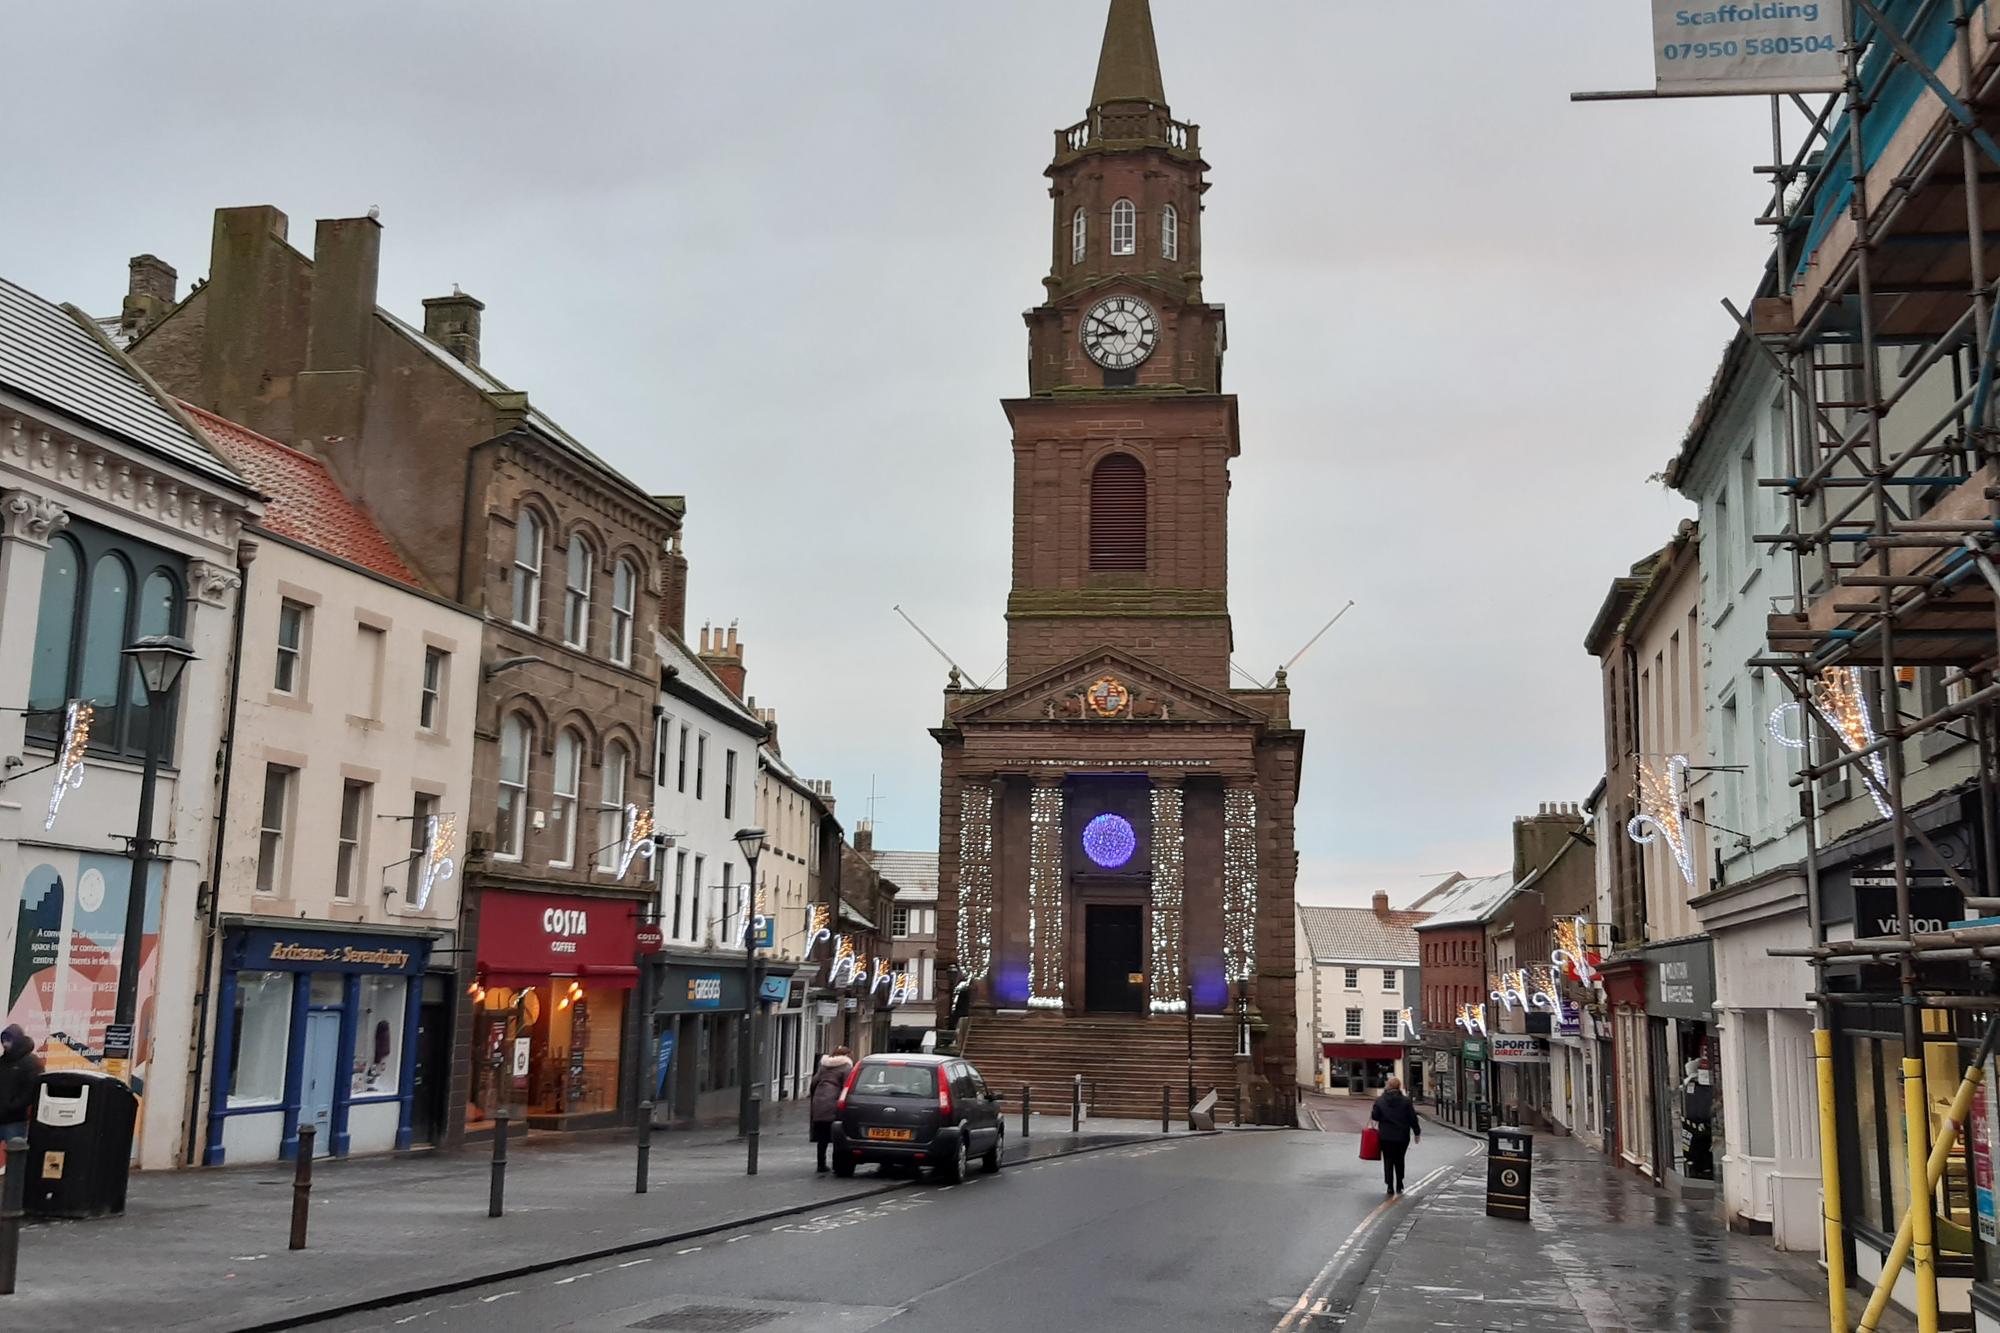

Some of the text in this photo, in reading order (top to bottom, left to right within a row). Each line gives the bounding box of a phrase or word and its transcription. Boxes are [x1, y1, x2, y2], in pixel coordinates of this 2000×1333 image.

[1676, 3, 1818, 26] Scaffolding
[1664, 35, 1835, 60] 07950 580504
[543, 907, 587, 937] COSTA
[342, 946, 410, 968] Serendipity
[551, 941, 577, 953] COFFEE
[695, 978, 721, 1000] GREGGS
[1495, 1040, 1538, 1049] SPORTS
